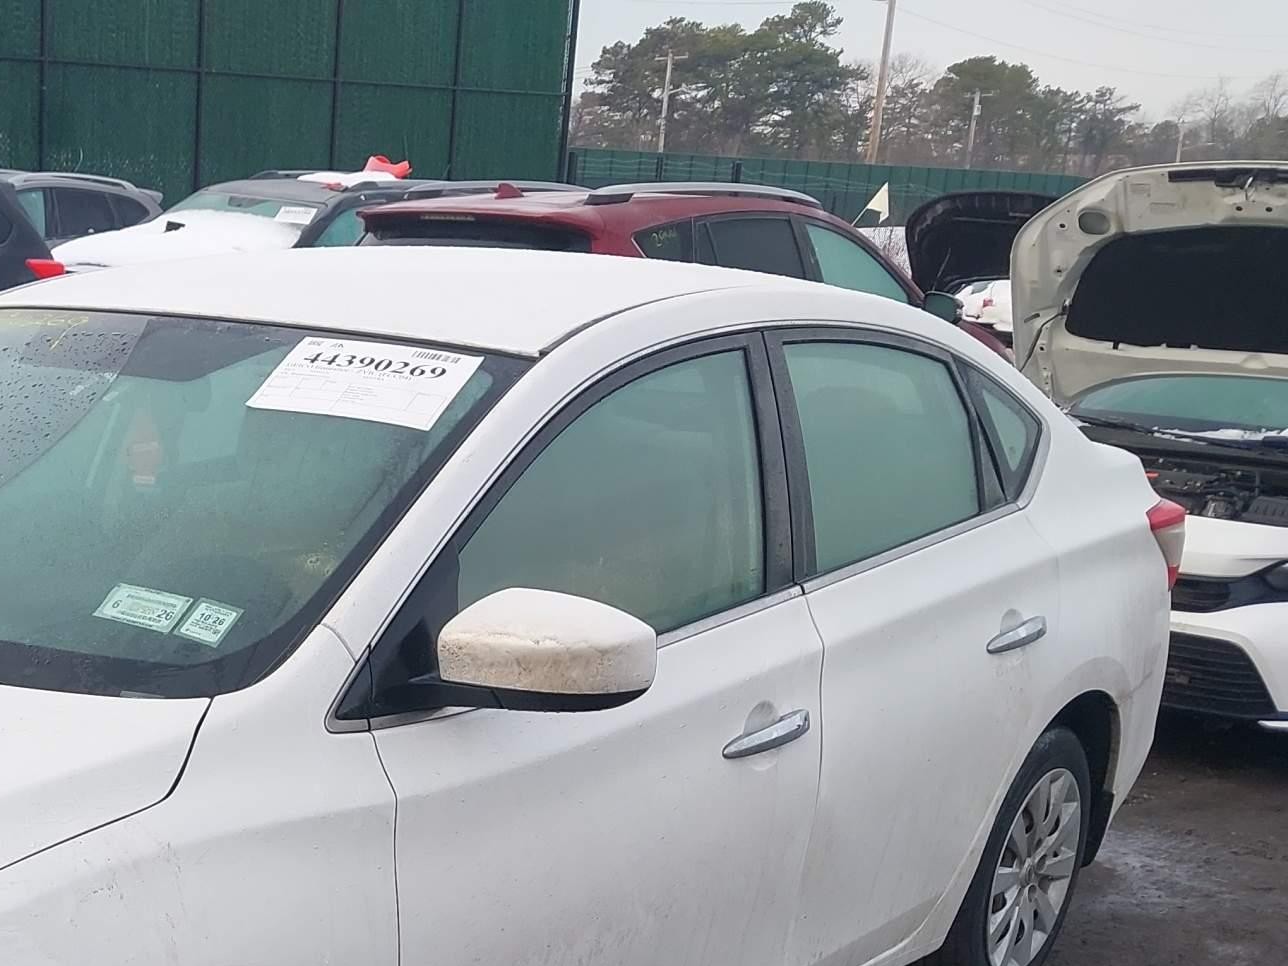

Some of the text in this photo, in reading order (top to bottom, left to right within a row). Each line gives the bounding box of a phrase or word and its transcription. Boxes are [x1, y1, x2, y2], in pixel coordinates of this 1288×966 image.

[303, 351, 448, 380] 44390269
[111, 599, 123, 609] 6
[155, 608, 175, 621] 26
